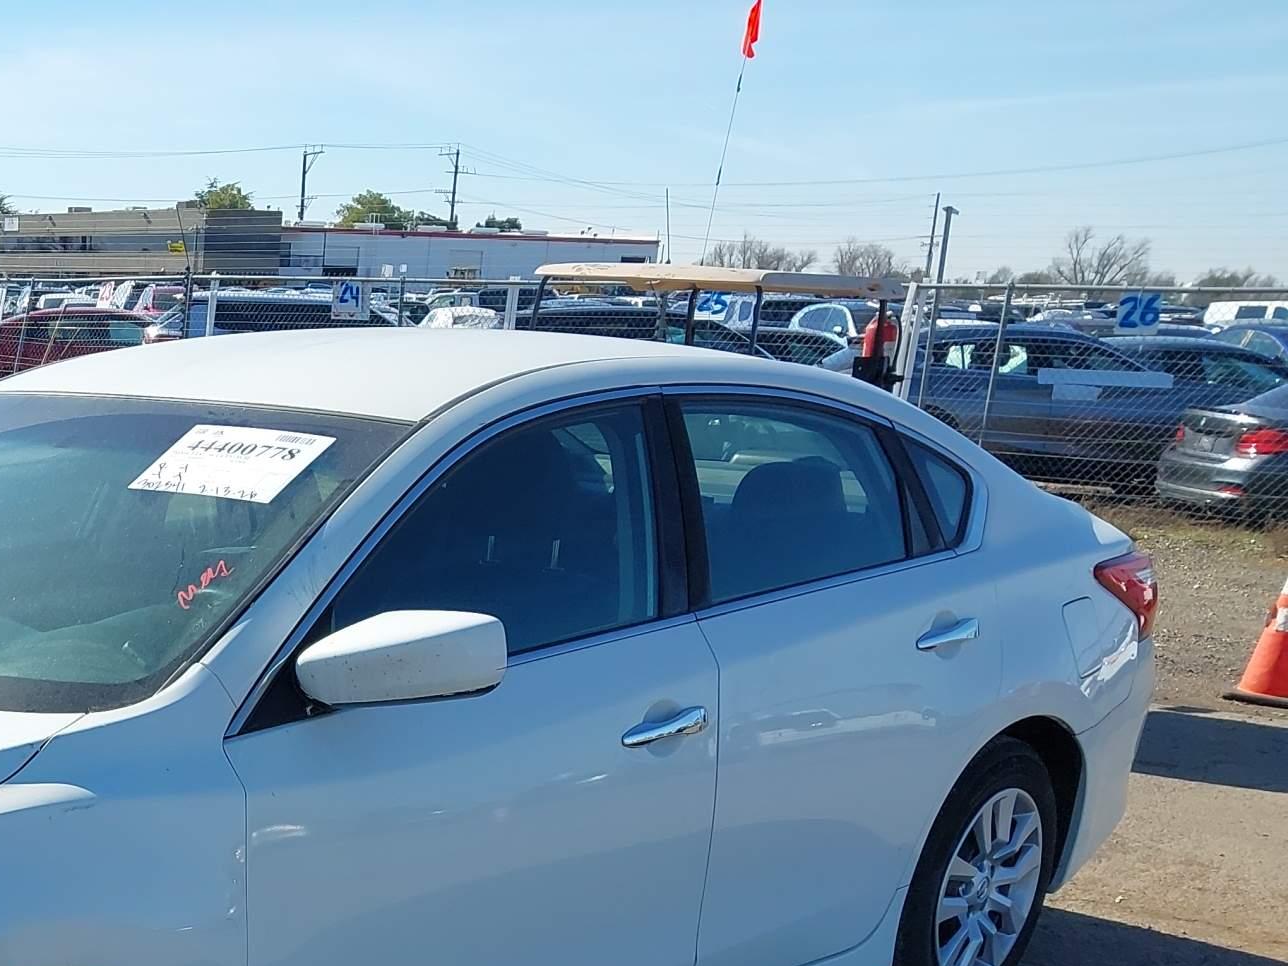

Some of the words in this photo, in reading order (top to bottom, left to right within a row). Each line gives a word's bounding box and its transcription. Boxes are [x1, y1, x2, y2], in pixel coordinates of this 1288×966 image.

[339, 281, 360, 308] 24
[696, 290, 728, 315] 25
[1118, 294, 1161, 329] 26
[186, 438, 302, 461] 44400778
